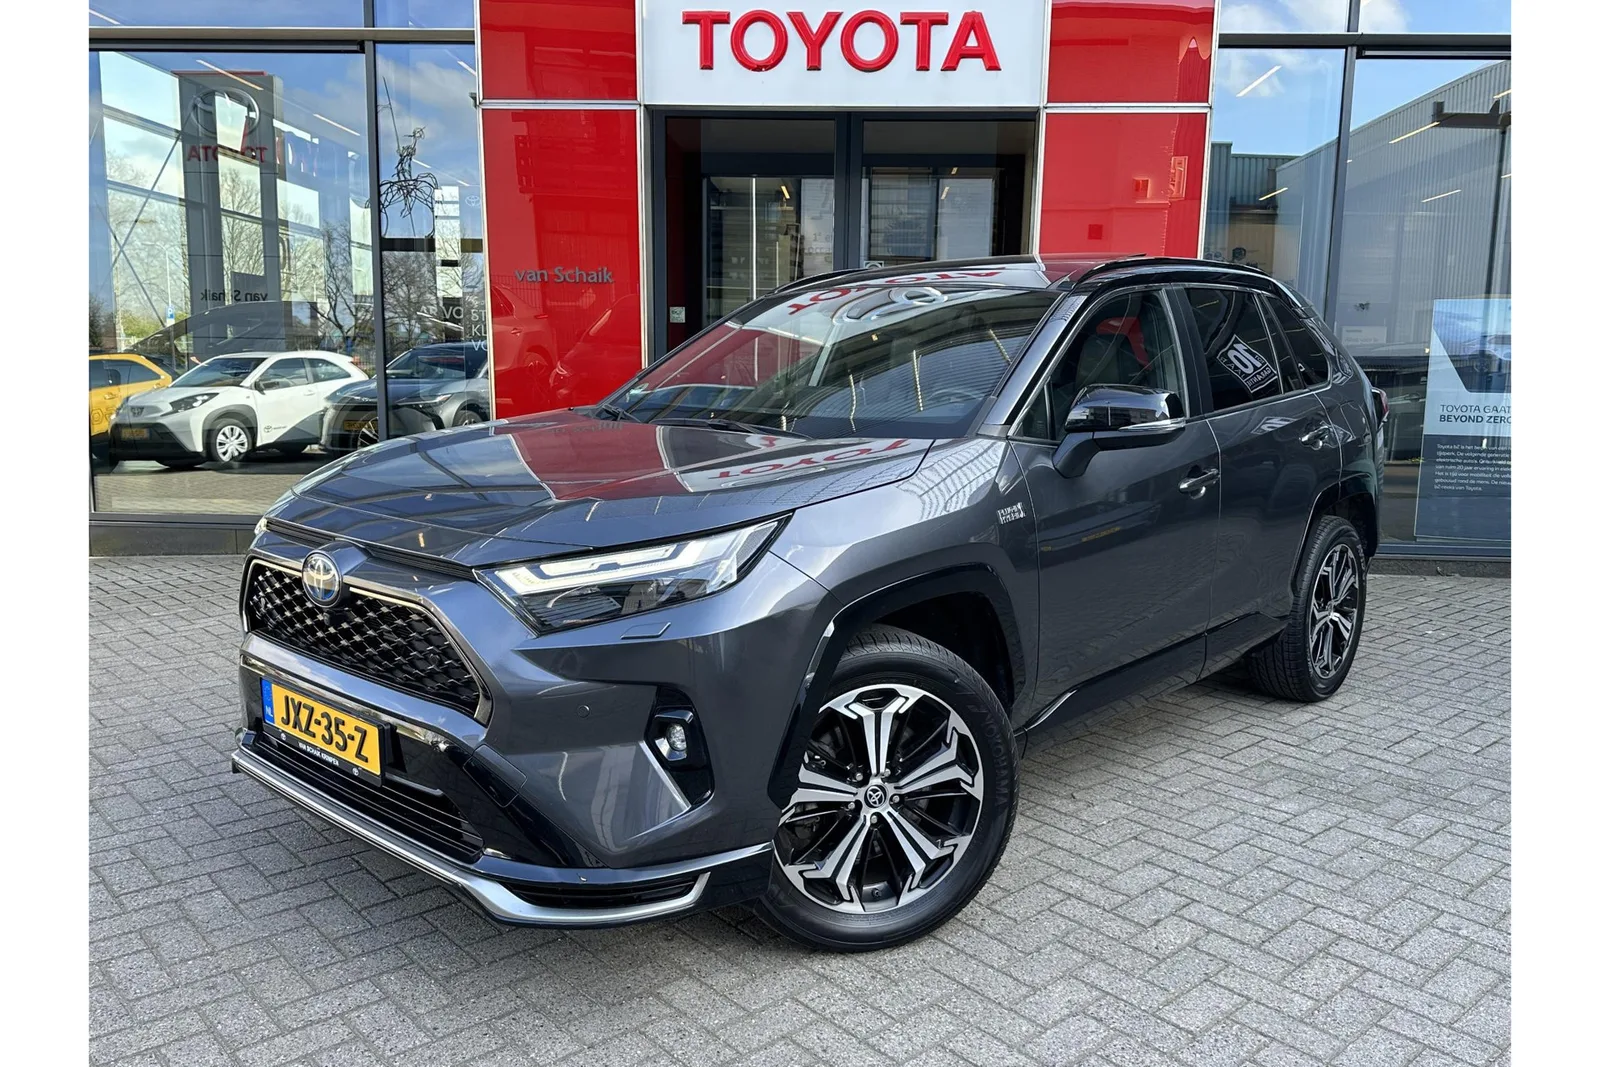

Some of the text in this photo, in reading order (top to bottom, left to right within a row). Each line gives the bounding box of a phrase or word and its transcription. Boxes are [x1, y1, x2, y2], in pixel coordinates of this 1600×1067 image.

[682, 9, 1002, 72] TOYOTA
[514, 266, 614, 283] van Schaik
[1440, 404, 1511, 414] TOYOTA GAAT
[1439, 414, 1484, 424] BEYOND
[265, 704, 274, 718] NL
[281, 694, 368, 764] JXZ-35-Z
